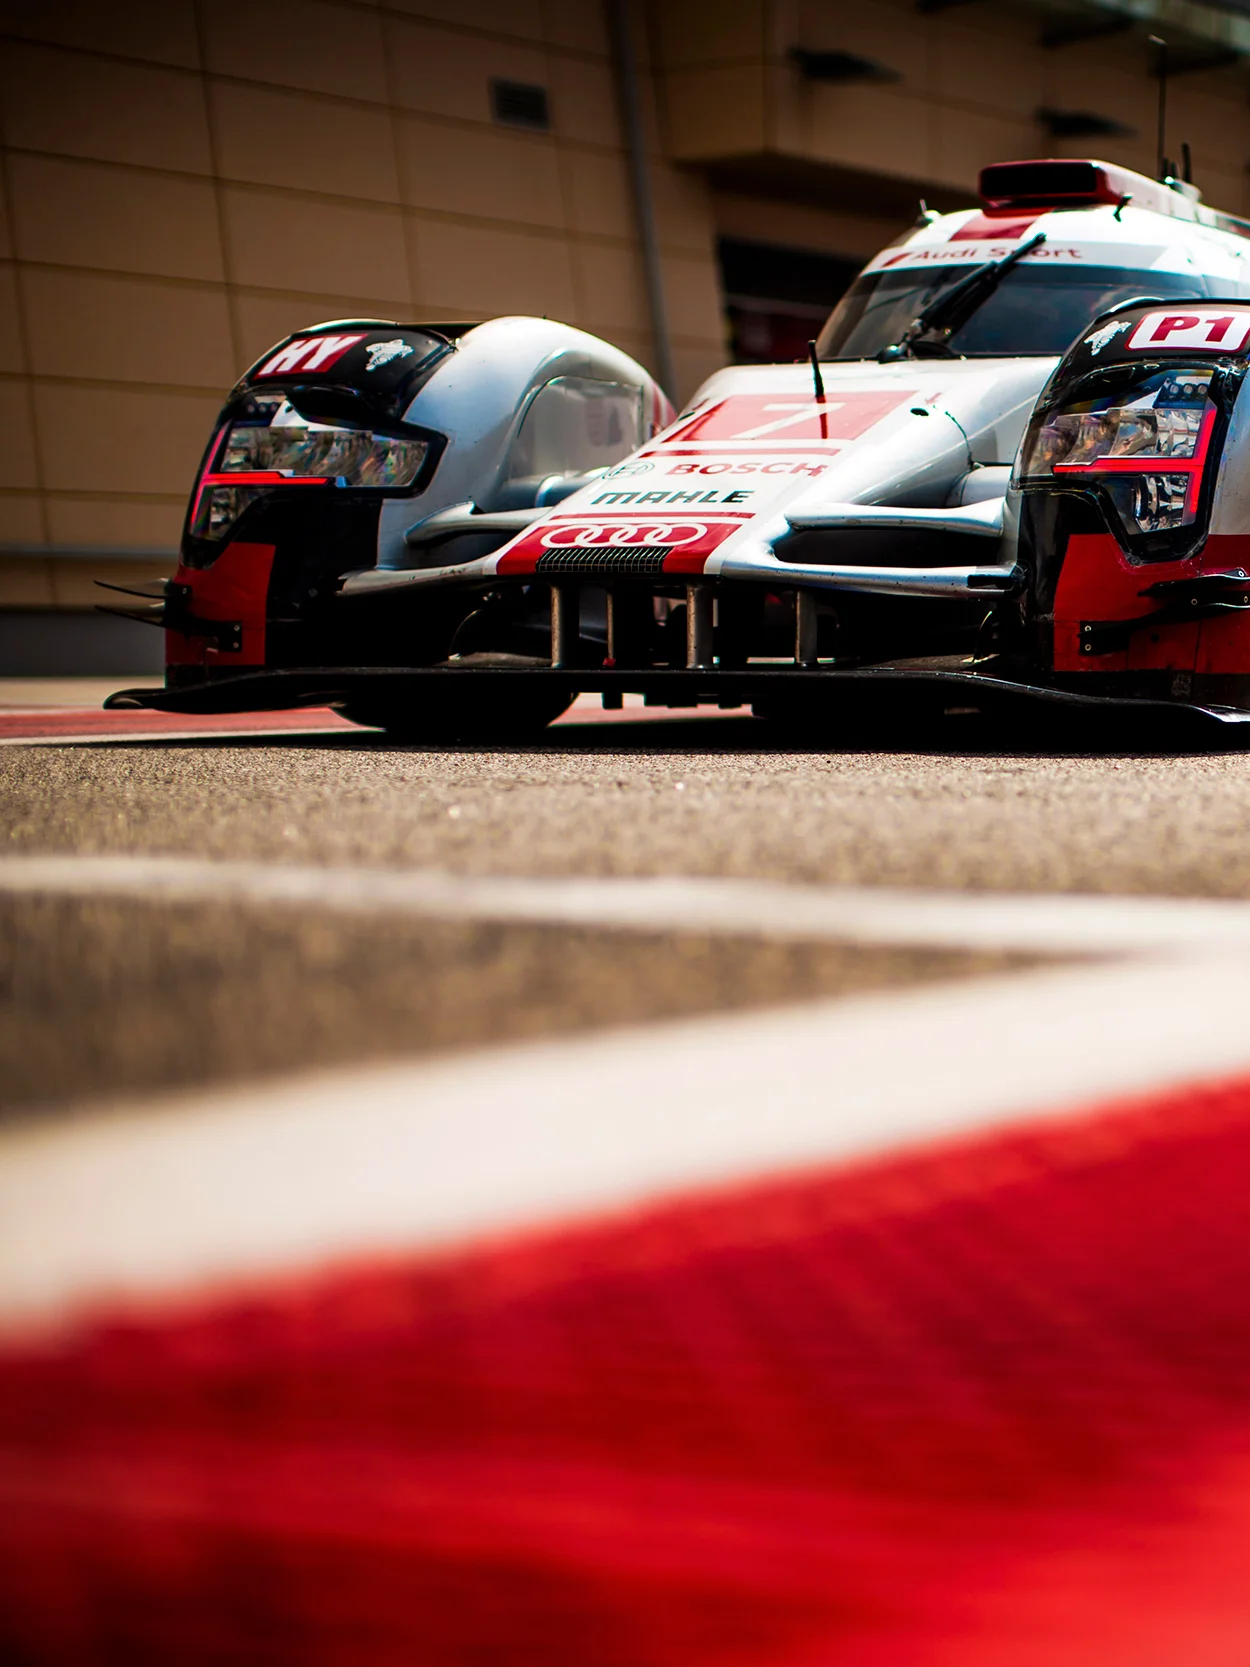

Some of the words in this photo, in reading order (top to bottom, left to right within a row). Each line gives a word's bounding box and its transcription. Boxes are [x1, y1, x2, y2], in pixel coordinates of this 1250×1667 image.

[912, 249, 976, 260] Audi
[986, 247, 1083, 260] Sort
[1149, 315, 1236, 343] P1
[257, 335, 364, 376] HY
[728, 401, 847, 440] 7
[664, 461, 829, 478] BOSCH
[590, 489, 756, 506] MAHLE
